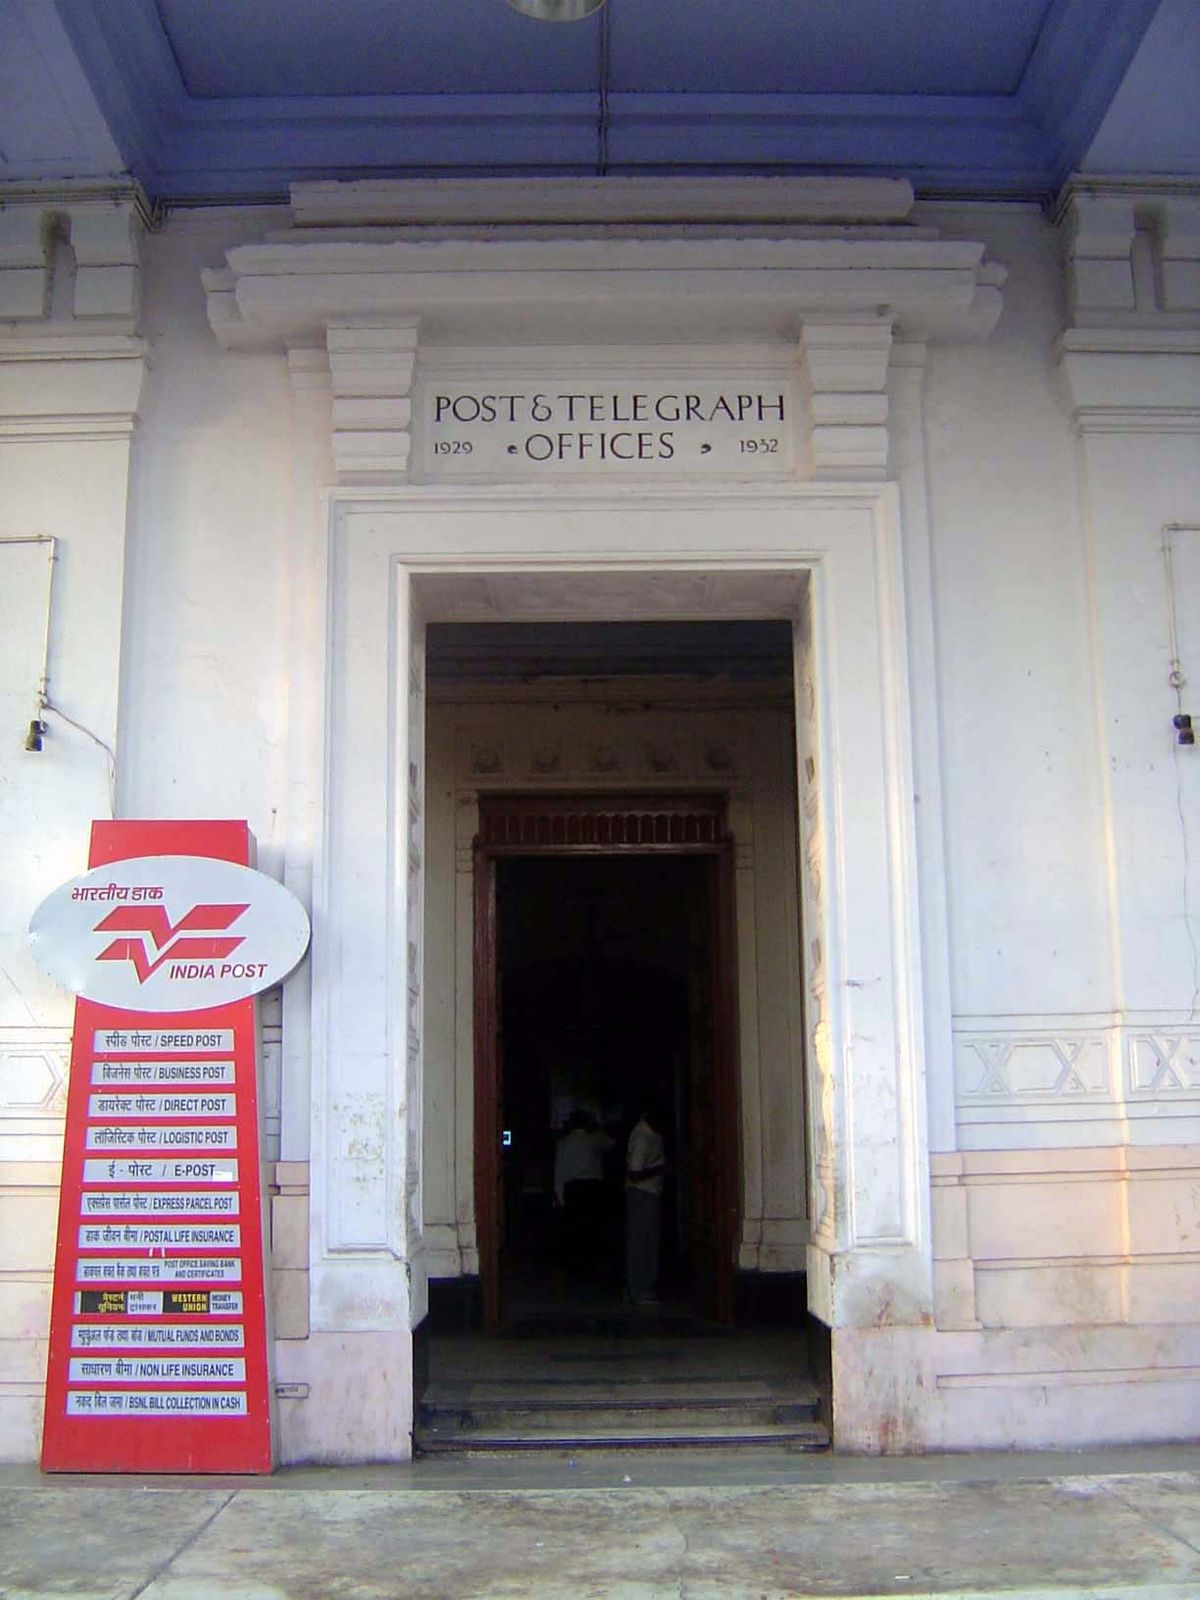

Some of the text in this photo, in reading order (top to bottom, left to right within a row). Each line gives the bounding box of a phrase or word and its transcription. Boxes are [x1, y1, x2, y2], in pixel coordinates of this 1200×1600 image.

[434, 394, 785, 422] POST & TELEGRAPH
[434, 433, 779, 461] 1929 OFFICES 1932
[71, 883, 164, 901] भारतीय डाक
[169, 964, 268, 979] INDIA POST
[131, 1032, 152, 1047] पोस्ट
[160, 1035, 194, 1047] SPEED
[196, 1035, 222, 1047] POST
[134, 1064, 151, 1079] पोस्ट
[159, 1067, 200, 1079] BUSINESS
[202, 1067, 225, 1079] POST
[136, 1096, 156, 1111] पोस्ट
[164, 1099, 199, 1111] DIRECT
[201, 1099, 226, 1111] POST
[138, 1128, 156, 1144] पोस्ट
[164, 1132, 203, 1144] LOGISTIC
[205, 1132, 228, 1144] POST
[128, 1161, 152, 1177] पोस्ट
[186, 1198, 213, 1210] PARCEL
[214, 1198, 232, 1210] POST
[144, 1230, 172, 1242] POSTAL
[174, 1230, 190, 1242] LIFE
[192, 1230, 234, 1242] INSURANCE
[172, 1294, 208, 1302] WESTERN
[182, 1303, 208, 1311] UNION
[200, 1330, 214, 1342] AND
[140, 1364, 160, 1376] NON
[162, 1364, 180, 1376] LIFE
[182, 1364, 234, 1376] INSURANCE
[150, 1396, 164, 1409] BILL
[166, 1396, 210, 1409] COLLECTION
[212, 1396, 219, 1409] IN
[220, 1396, 240, 1409] CASH
